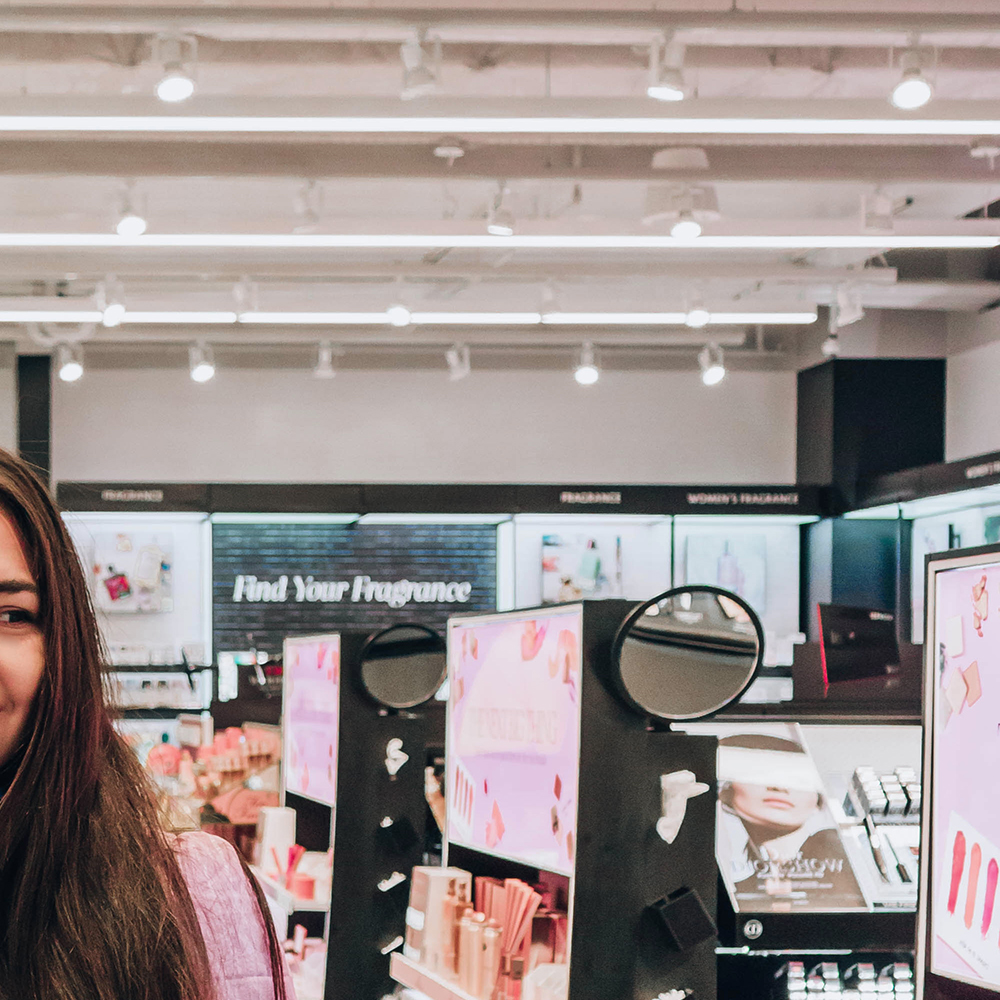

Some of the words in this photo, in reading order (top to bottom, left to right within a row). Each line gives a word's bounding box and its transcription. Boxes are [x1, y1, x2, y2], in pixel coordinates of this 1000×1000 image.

[561, 492, 622, 504] FRAGRANCE
[233, 575, 288, 602] Find
[293, 575, 350, 602] Your
[352, 575, 472, 608] Fragrance
